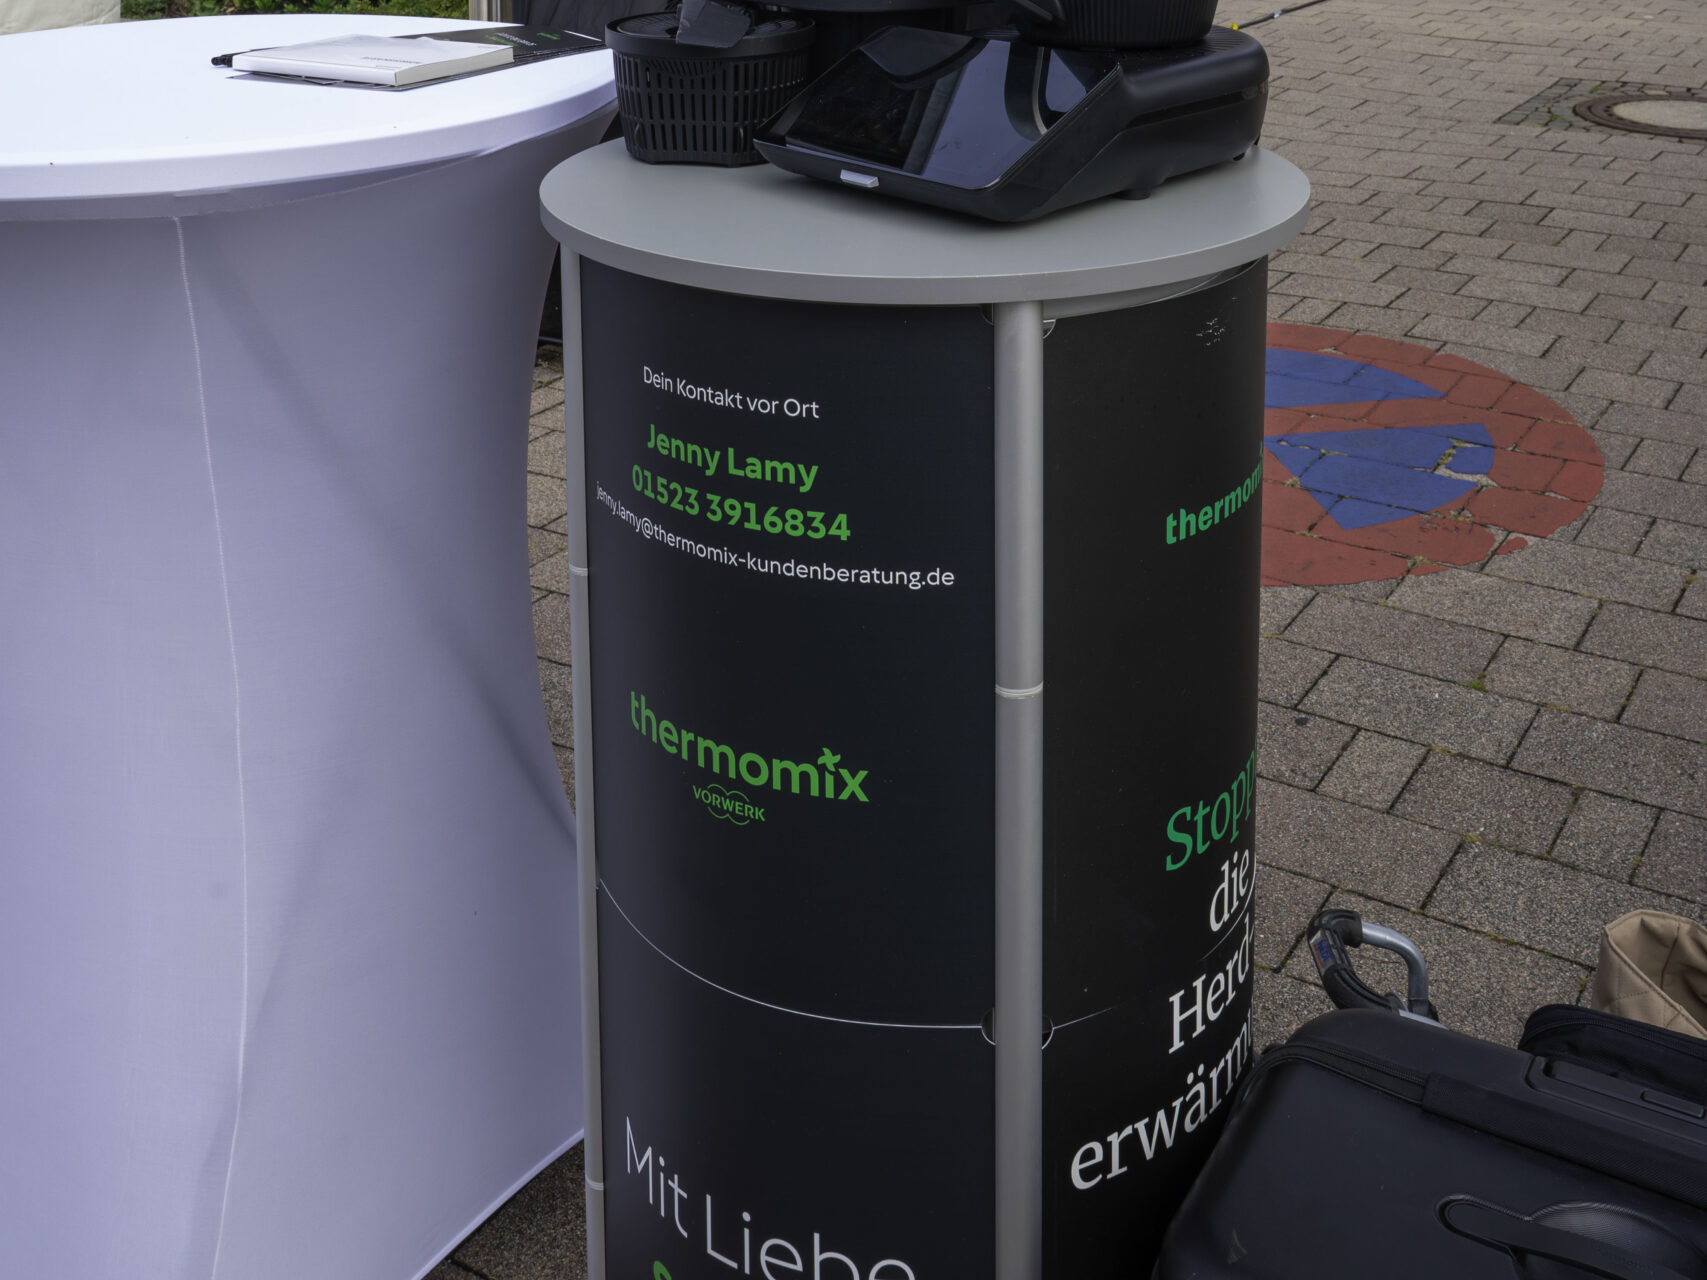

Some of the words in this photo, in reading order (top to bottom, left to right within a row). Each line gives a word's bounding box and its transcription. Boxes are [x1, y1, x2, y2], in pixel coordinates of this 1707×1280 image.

[643, 365, 673, 393] Dein
[677, 379, 743, 410] Kontakt
[747, 396, 779, 415] vor
[784, 398, 820, 419] Ort
[647, 424, 721, 477] Jenny
[728, 447, 819, 493] Lamy
[596, 481, 955, 590] jenny.lamy@thermomix-kundenberatung.de
[632, 464, 700, 516] 01523
[706, 493, 851, 542] 3916834
[631, 691, 870, 802] thermomix
[692, 784, 766, 823] VORWERK
[1165, 742, 1257, 871] Stopp
[1209, 848, 1250, 933] die
[626, 1116, 688, 1238] Mit
